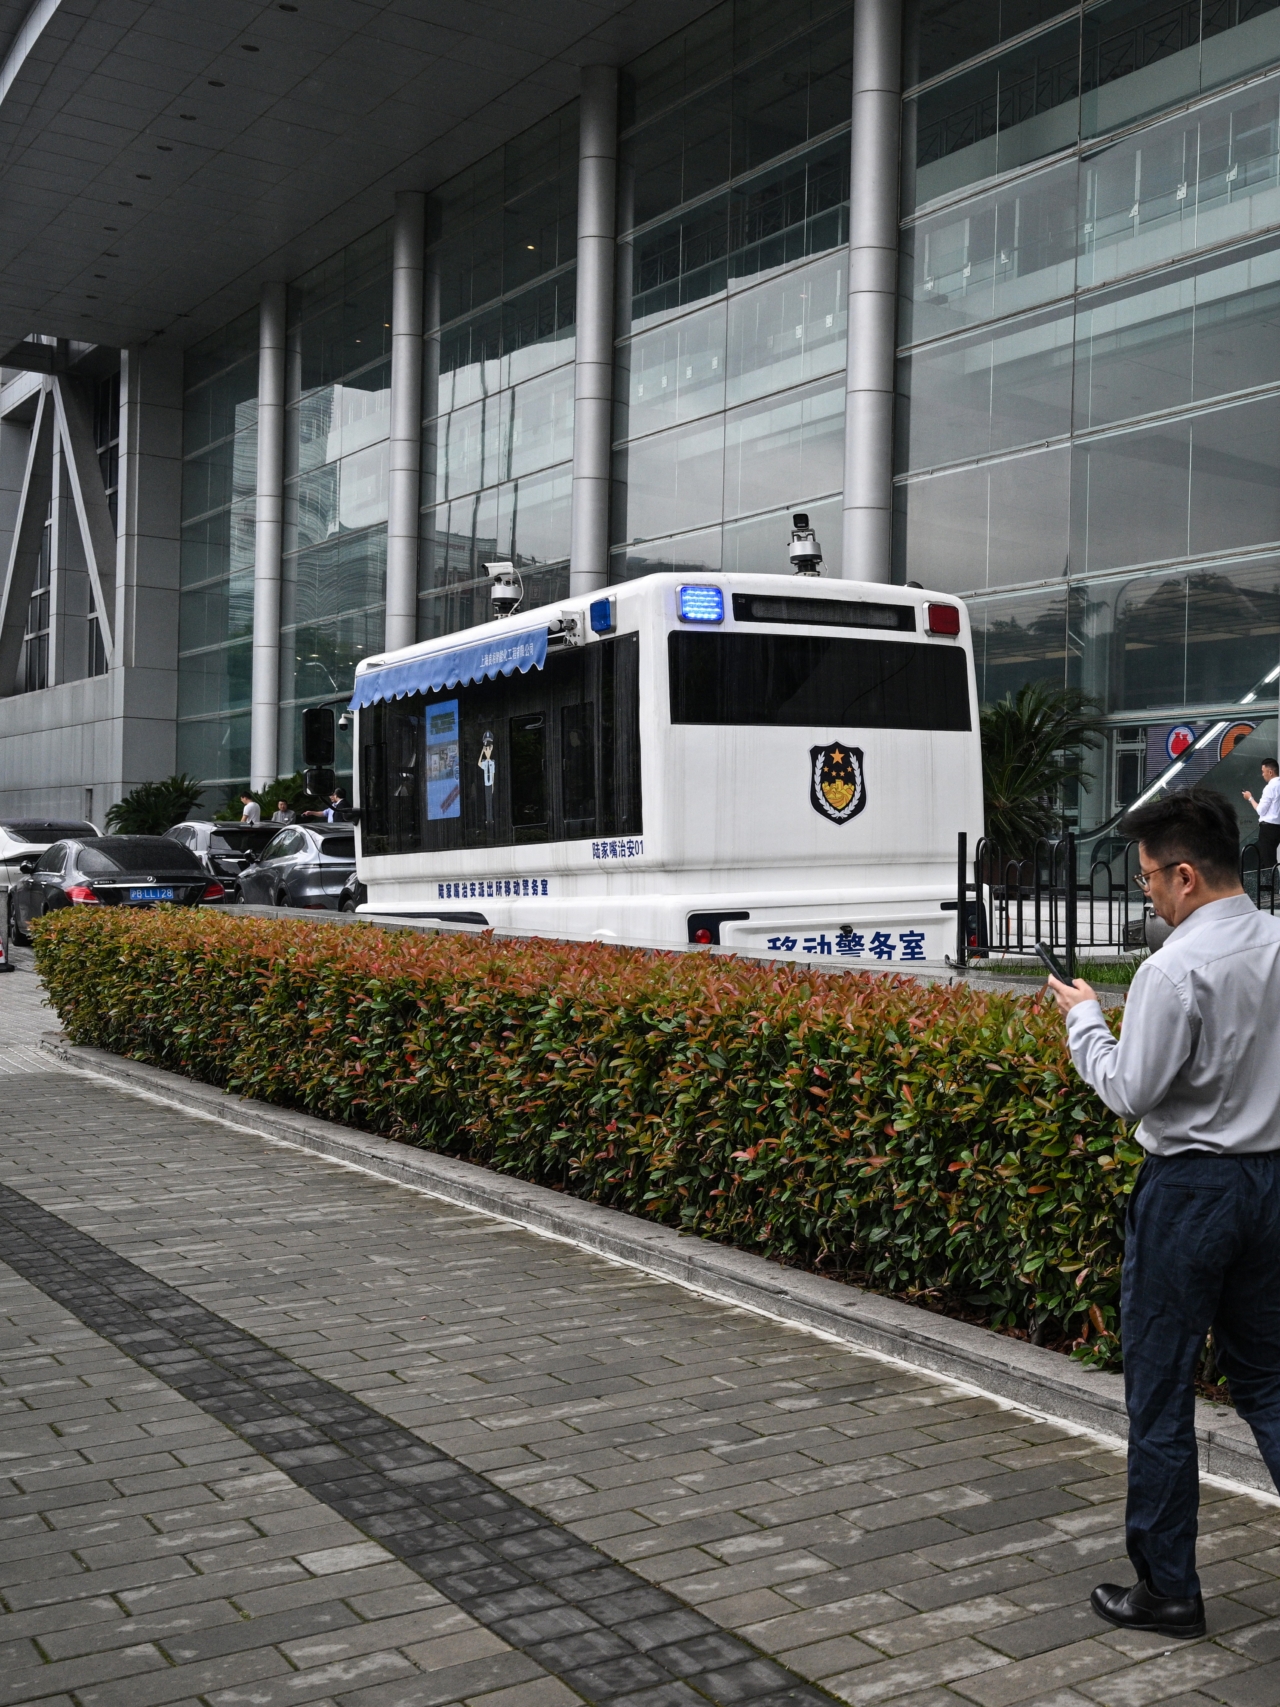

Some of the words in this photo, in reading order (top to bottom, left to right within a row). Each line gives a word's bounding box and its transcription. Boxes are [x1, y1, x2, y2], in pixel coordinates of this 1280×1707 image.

[592, 839, 644, 860] 陆家嘴治安01
[438, 879, 549, 899] 陆家嘴治安派出所移动警务室
